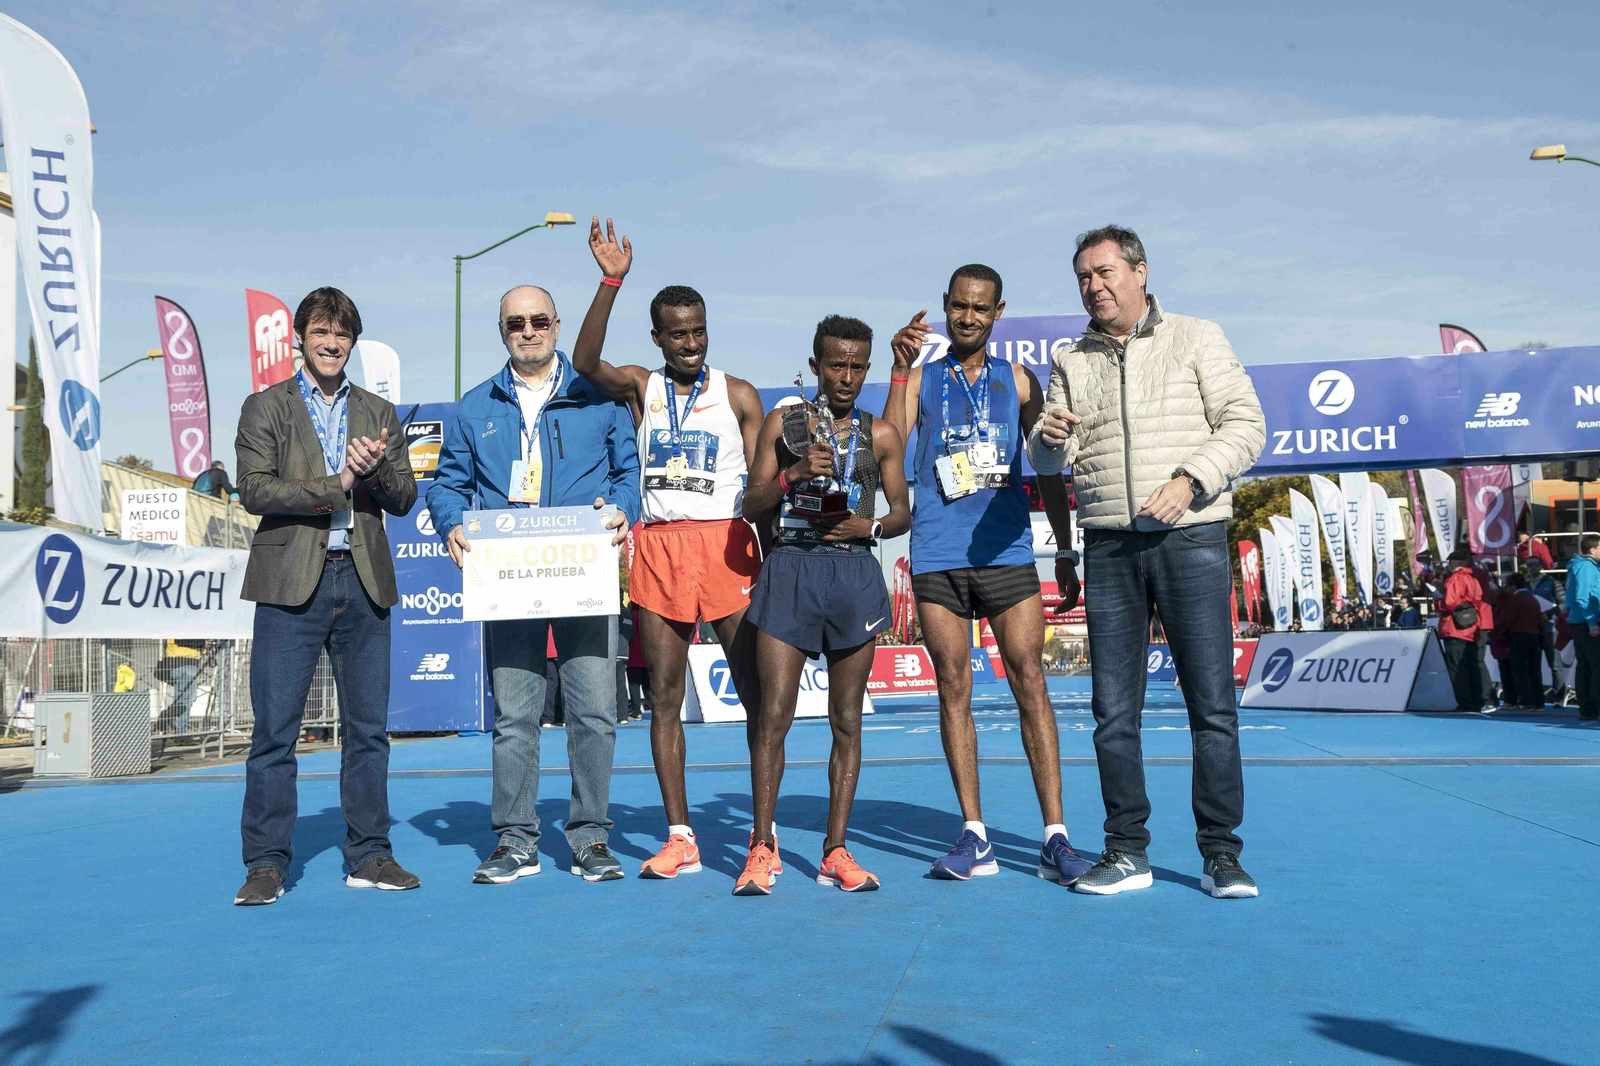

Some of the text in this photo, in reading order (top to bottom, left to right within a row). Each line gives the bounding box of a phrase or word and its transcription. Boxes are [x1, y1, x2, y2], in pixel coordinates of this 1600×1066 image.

[1465, 418, 1530, 429] new balance
[407, 425, 434, 436] IAAF
[680, 434, 712, 445] URICH
[1272, 425, 1397, 455] ZURICH
[128, 492, 178, 504] PUESTO
[129, 508, 180, 521] MÉDICO
[519, 515, 577, 529] ZURICH
[136, 530, 178, 542] samu
[396, 542, 450, 558] ZURIC
[485, 542, 598, 569] RECORD
[498, 566, 586, 580] DE LA PRUEBA
[101, 563, 226, 611] ZURICH
[425, 672, 454, 681] balance
[1297, 658, 1396, 683] ZURICH
[893, 680, 908, 688] new
